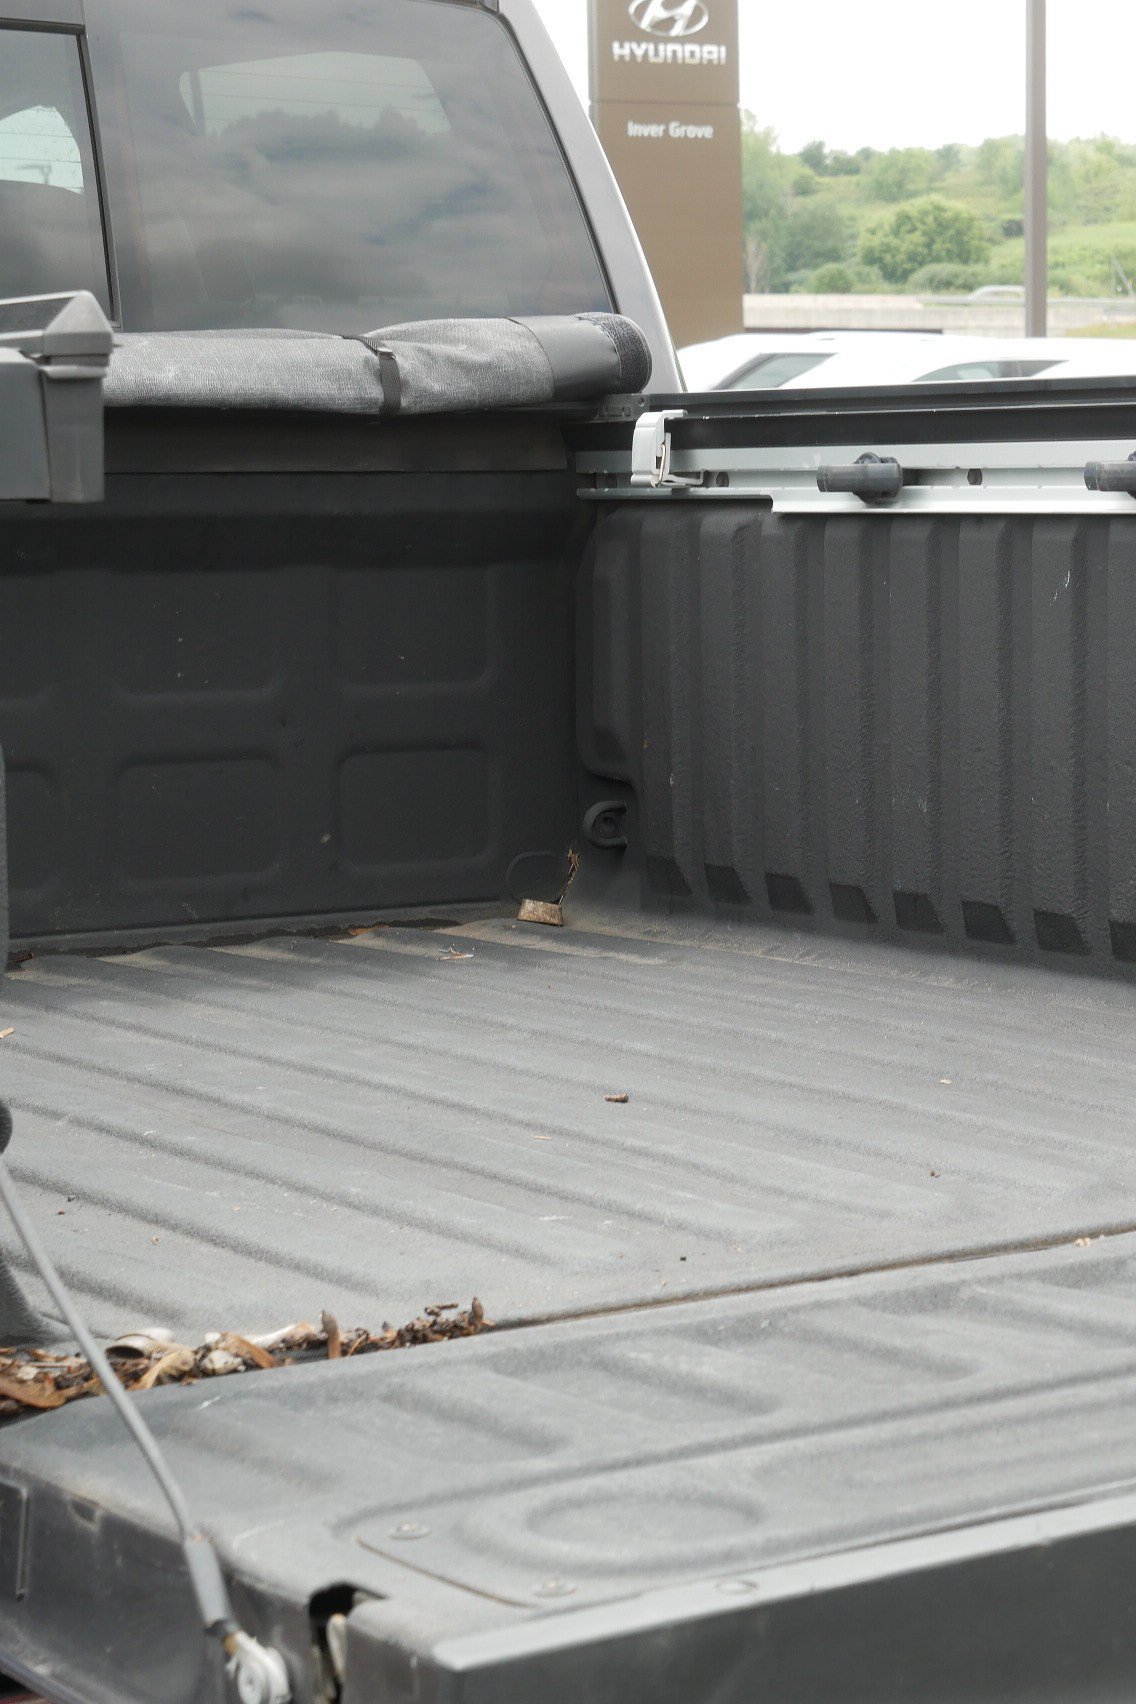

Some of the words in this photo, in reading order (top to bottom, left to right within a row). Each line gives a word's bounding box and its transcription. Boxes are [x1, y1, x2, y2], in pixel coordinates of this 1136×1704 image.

[611, 41, 727, 65] HYUNDAI
[627, 120, 665, 137] Inver
[668, 121, 714, 139] Grove
